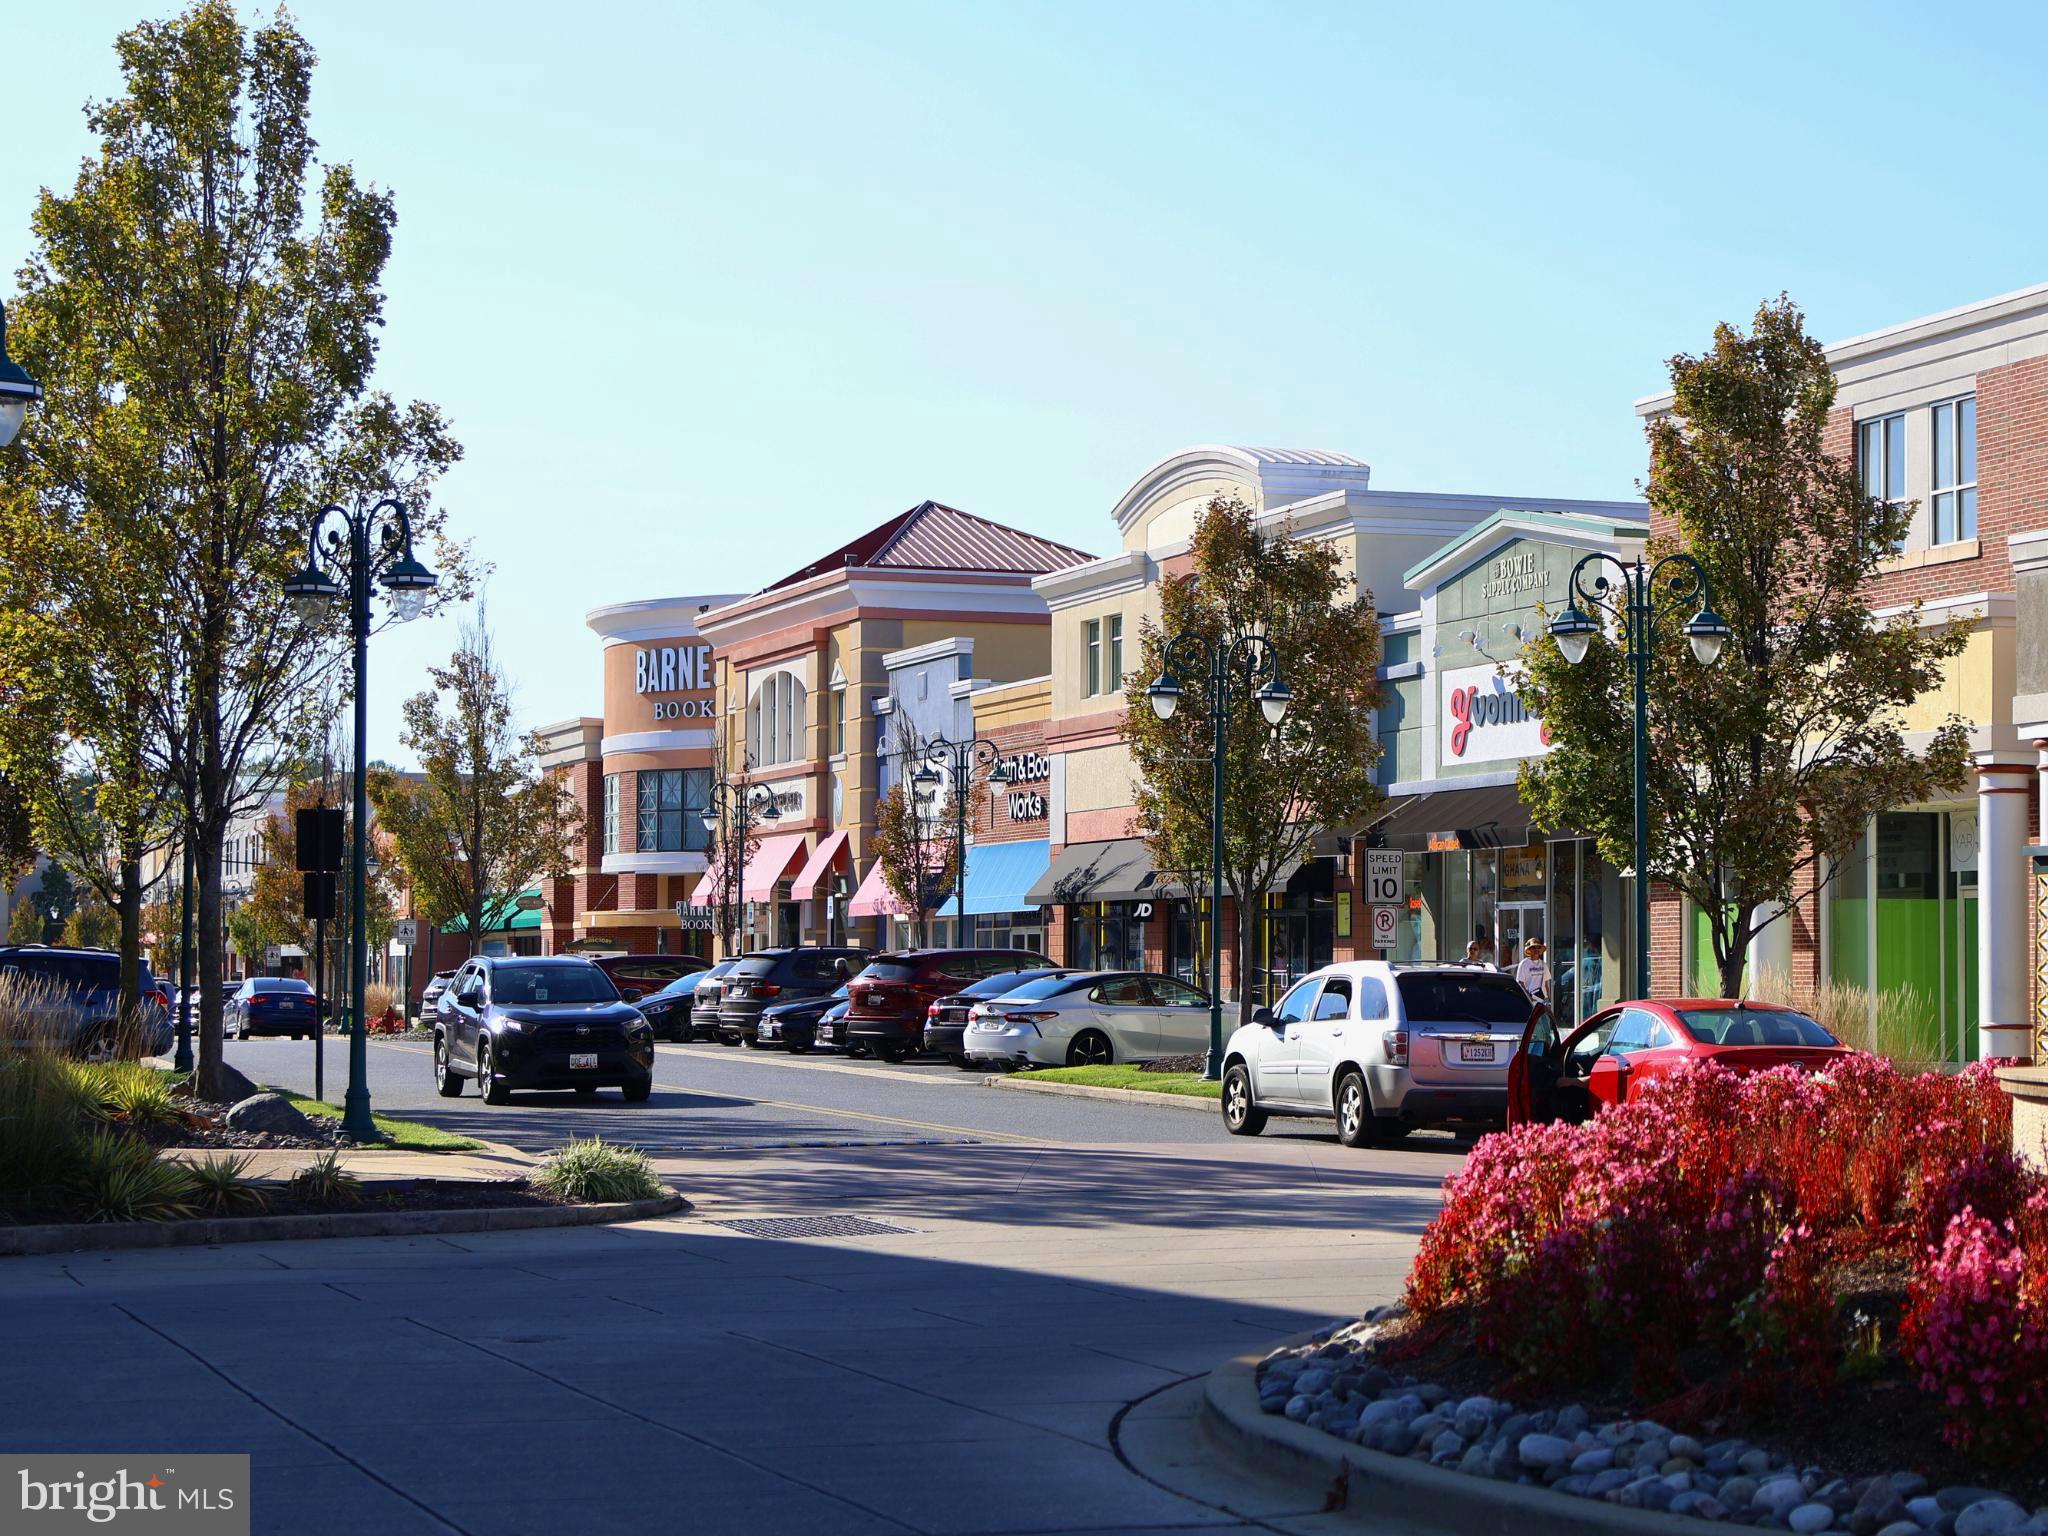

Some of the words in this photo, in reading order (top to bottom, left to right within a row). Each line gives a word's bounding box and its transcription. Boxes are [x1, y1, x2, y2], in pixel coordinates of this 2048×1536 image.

[1500, 552, 1534, 579] BOWIE
[1481, 578, 1511, 599] SUPPLY
[1512, 570, 1550, 593] COMPANY
[636, 645, 716, 693] BARNE
[1018, 755, 1026, 780] &
[1008, 791, 1041, 819] Works
[1369, 854, 1401, 863] SPEED
[1372, 866, 1398, 875] LIMIT
[1372, 878, 1398, 899] 10
[1133, 903, 1152, 917] JD
